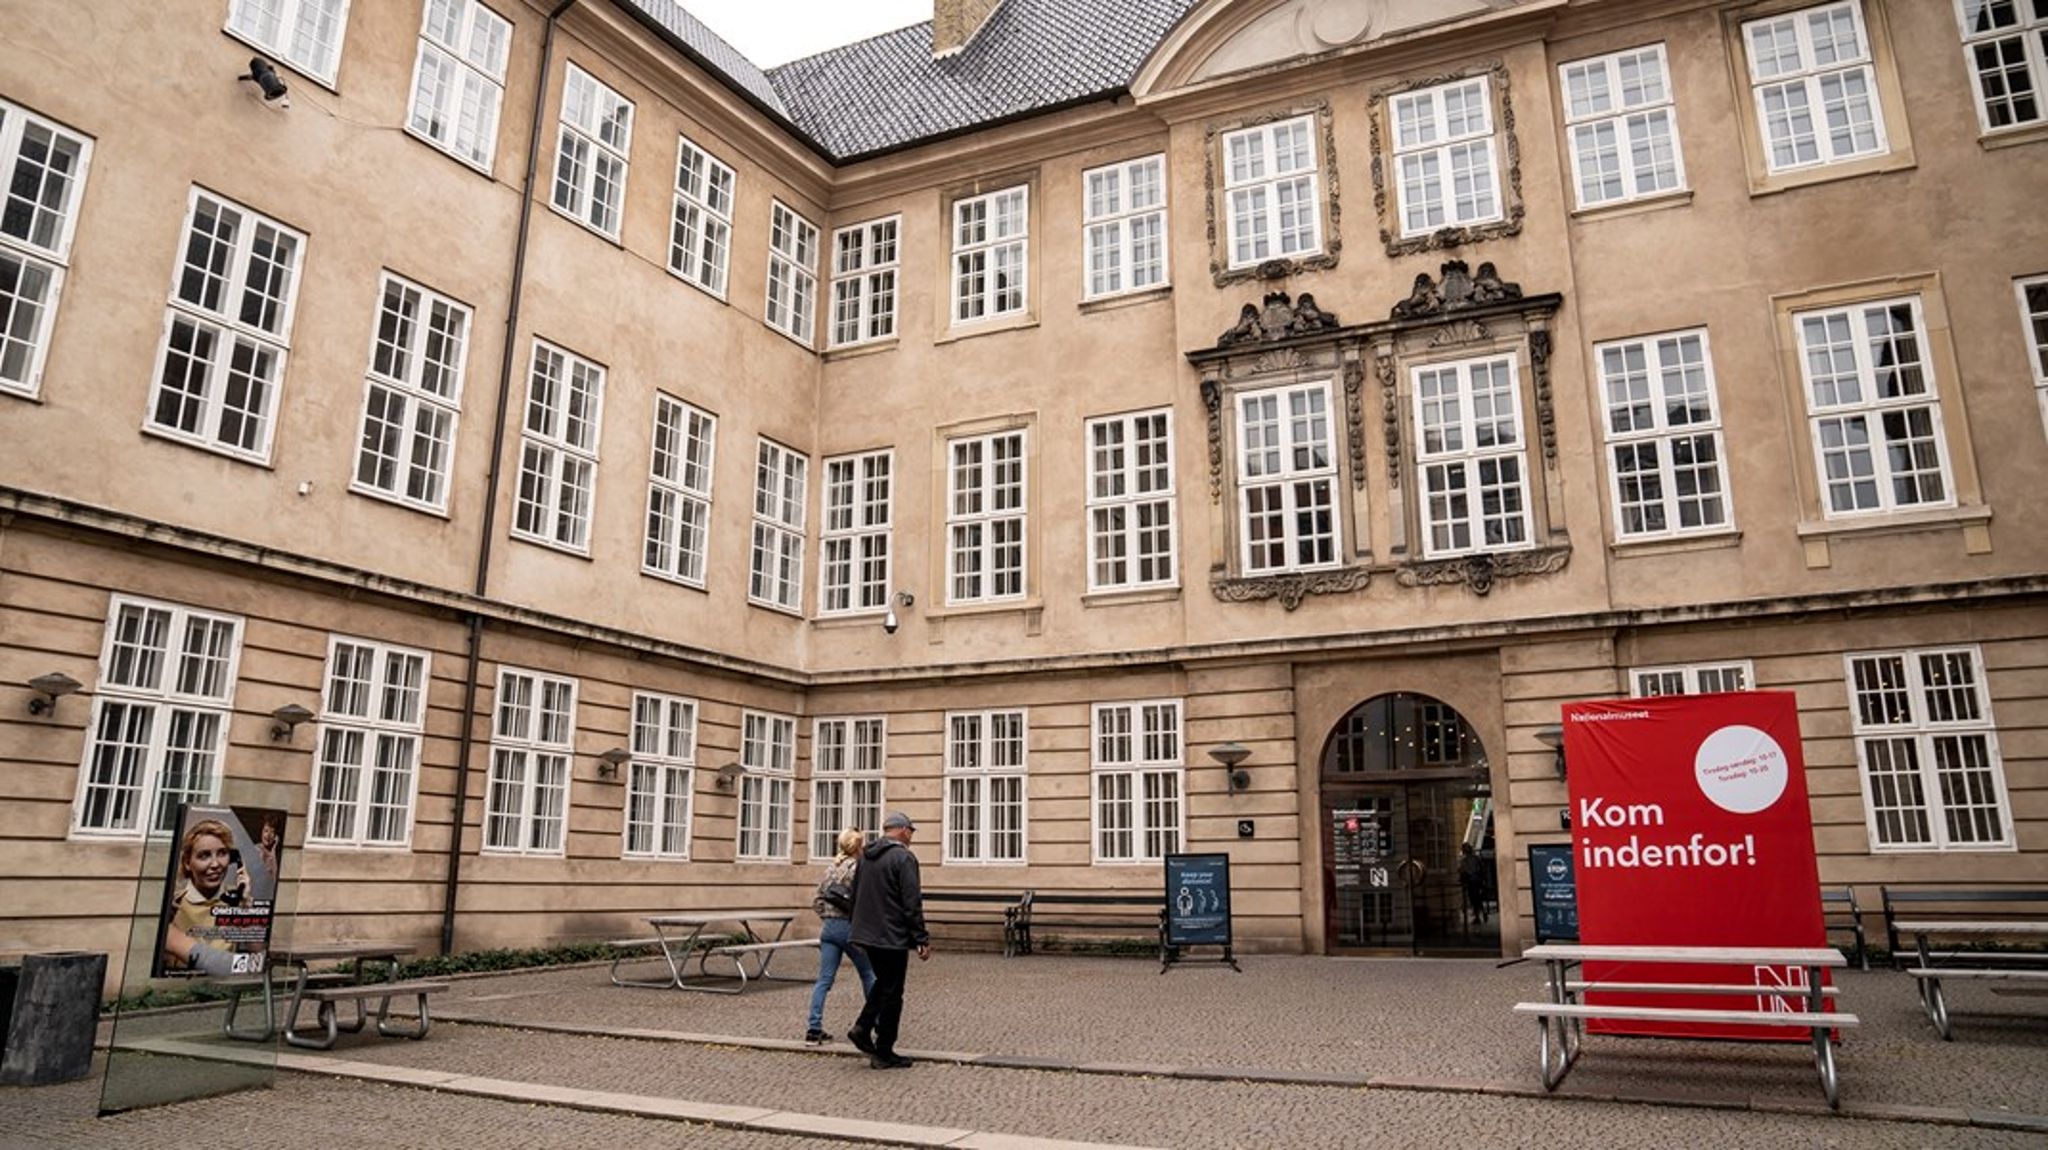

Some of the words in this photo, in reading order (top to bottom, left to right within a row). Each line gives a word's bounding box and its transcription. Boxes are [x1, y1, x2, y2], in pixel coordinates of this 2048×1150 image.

[1570, 710, 1650, 722] Nationalmuseet
[1580, 797, 1664, 828] Kom
[1582, 834, 1756, 868] indenfor!
